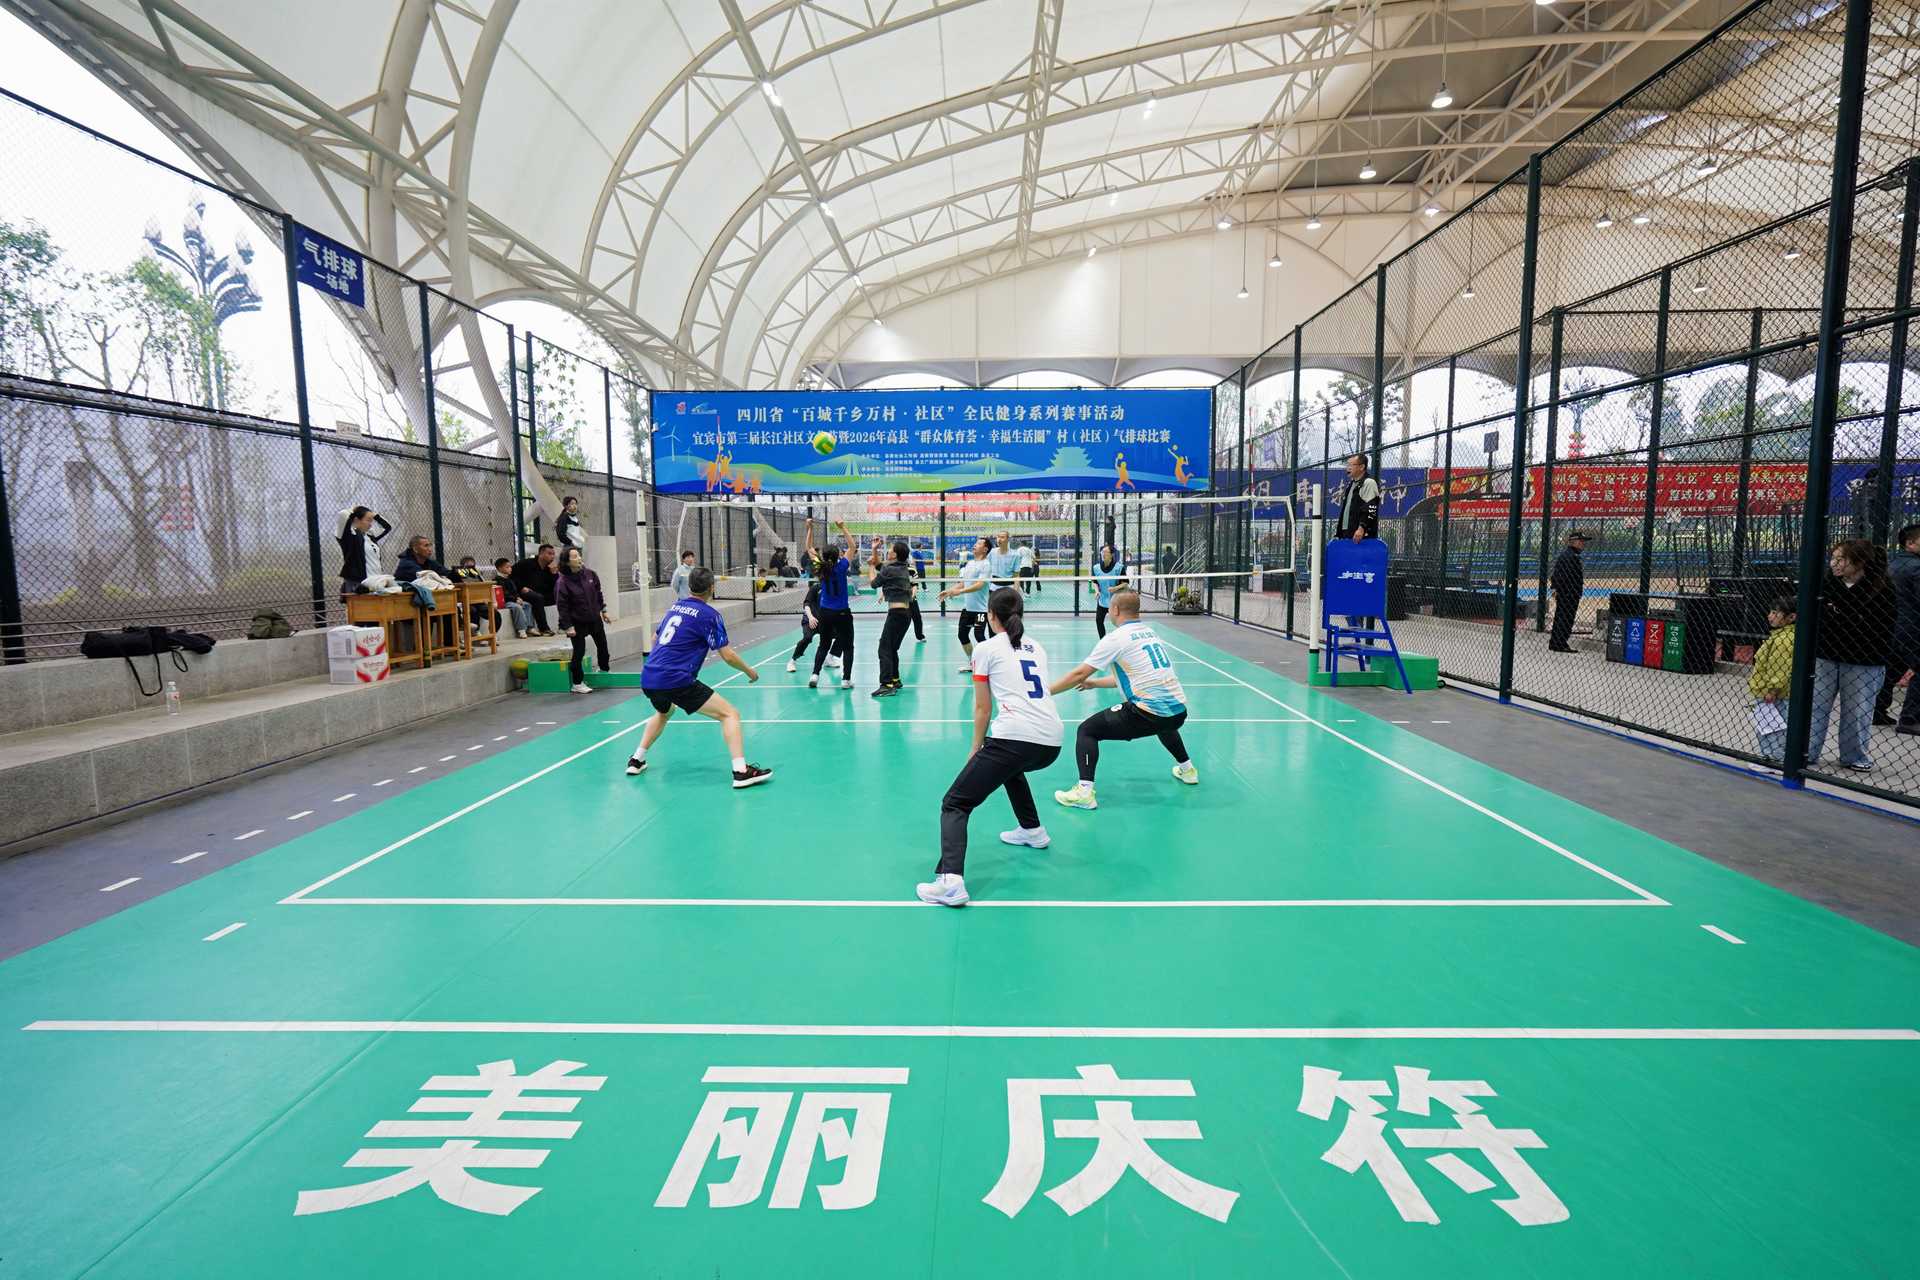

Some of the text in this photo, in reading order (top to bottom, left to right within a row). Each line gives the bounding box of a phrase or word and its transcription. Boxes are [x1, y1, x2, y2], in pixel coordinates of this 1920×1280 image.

[303, 238, 358, 280] 气排球
[659, 615, 682, 645] 6
[977, 613, 985, 622] 16
[1142, 642, 1170, 670] 10
[1019, 659, 1044, 698] 5
[293, 1059, 1570, 1226] 美丽庆符
